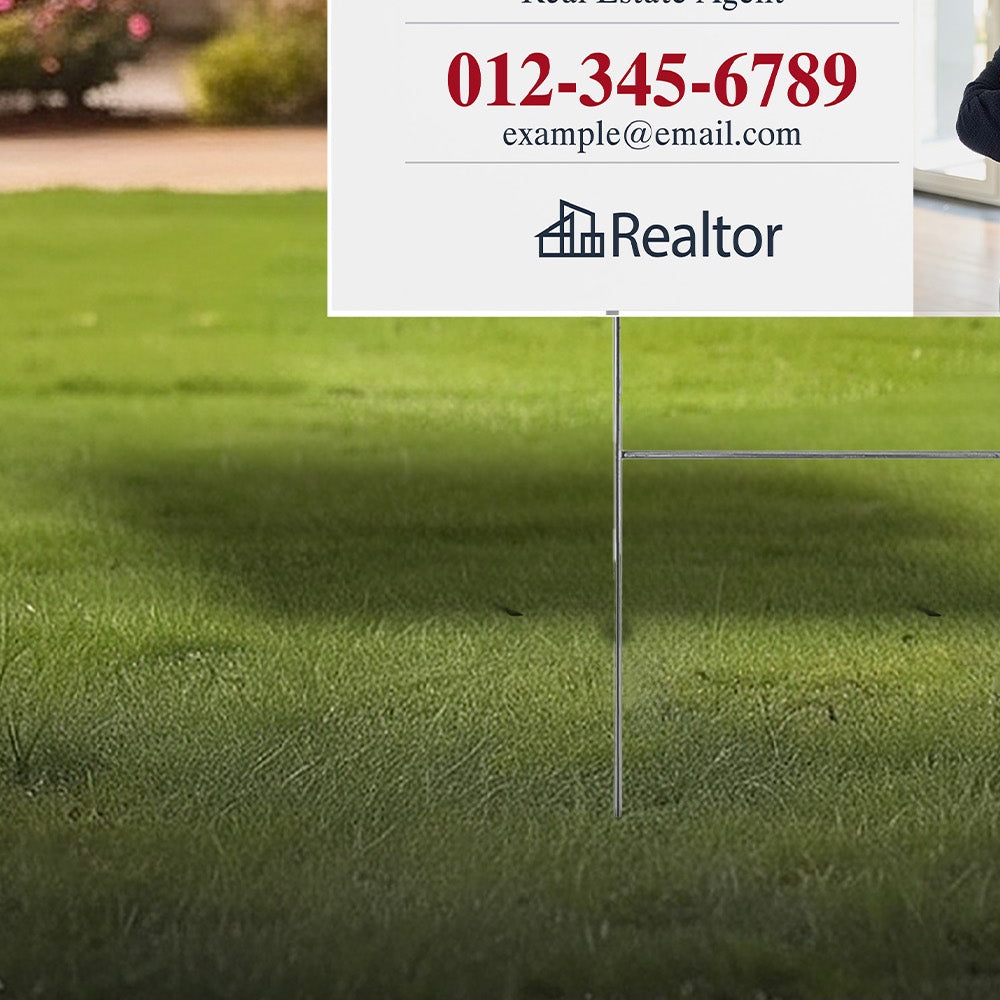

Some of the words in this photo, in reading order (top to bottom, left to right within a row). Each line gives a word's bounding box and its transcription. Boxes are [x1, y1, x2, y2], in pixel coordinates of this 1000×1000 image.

[447, 52, 857, 107] 012-345-6789
[502, 119, 802, 154] example@email.com
[612, 210, 783, 258] Realtor
